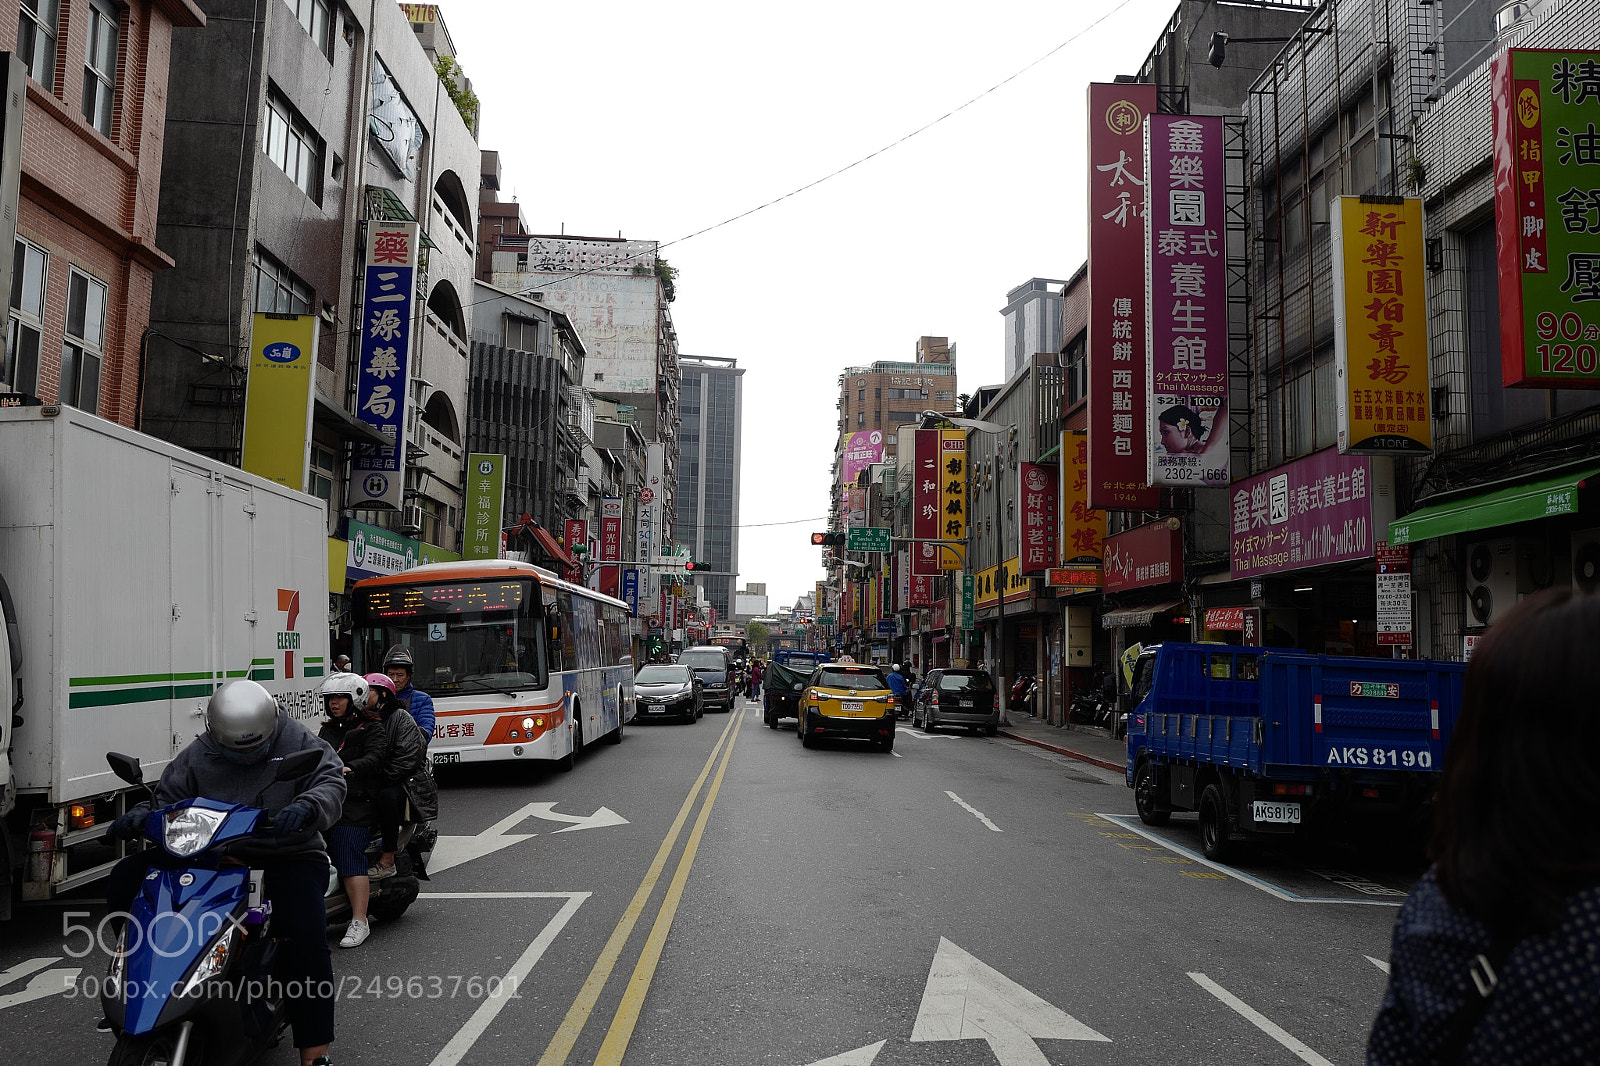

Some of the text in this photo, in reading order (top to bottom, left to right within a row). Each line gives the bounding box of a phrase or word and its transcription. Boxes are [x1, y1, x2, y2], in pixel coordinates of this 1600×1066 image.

[1156, 382, 1225, 393] Thai Massage
[1193, 397, 1221, 406] 1000
[943, 441, 964, 450] CHB
[1373, 438, 1409, 448] STORE
[1165, 468, 1228, 480] 2302-1666
[1112, 492, 1138, 502] 1946
[475, 479, 492, 542] 幸福診所
[1027, 492, 1045, 564] 好味老店
[1234, 551, 1289, 572] Thai Massage
[1327, 746, 1433, 768] AKS 8190
